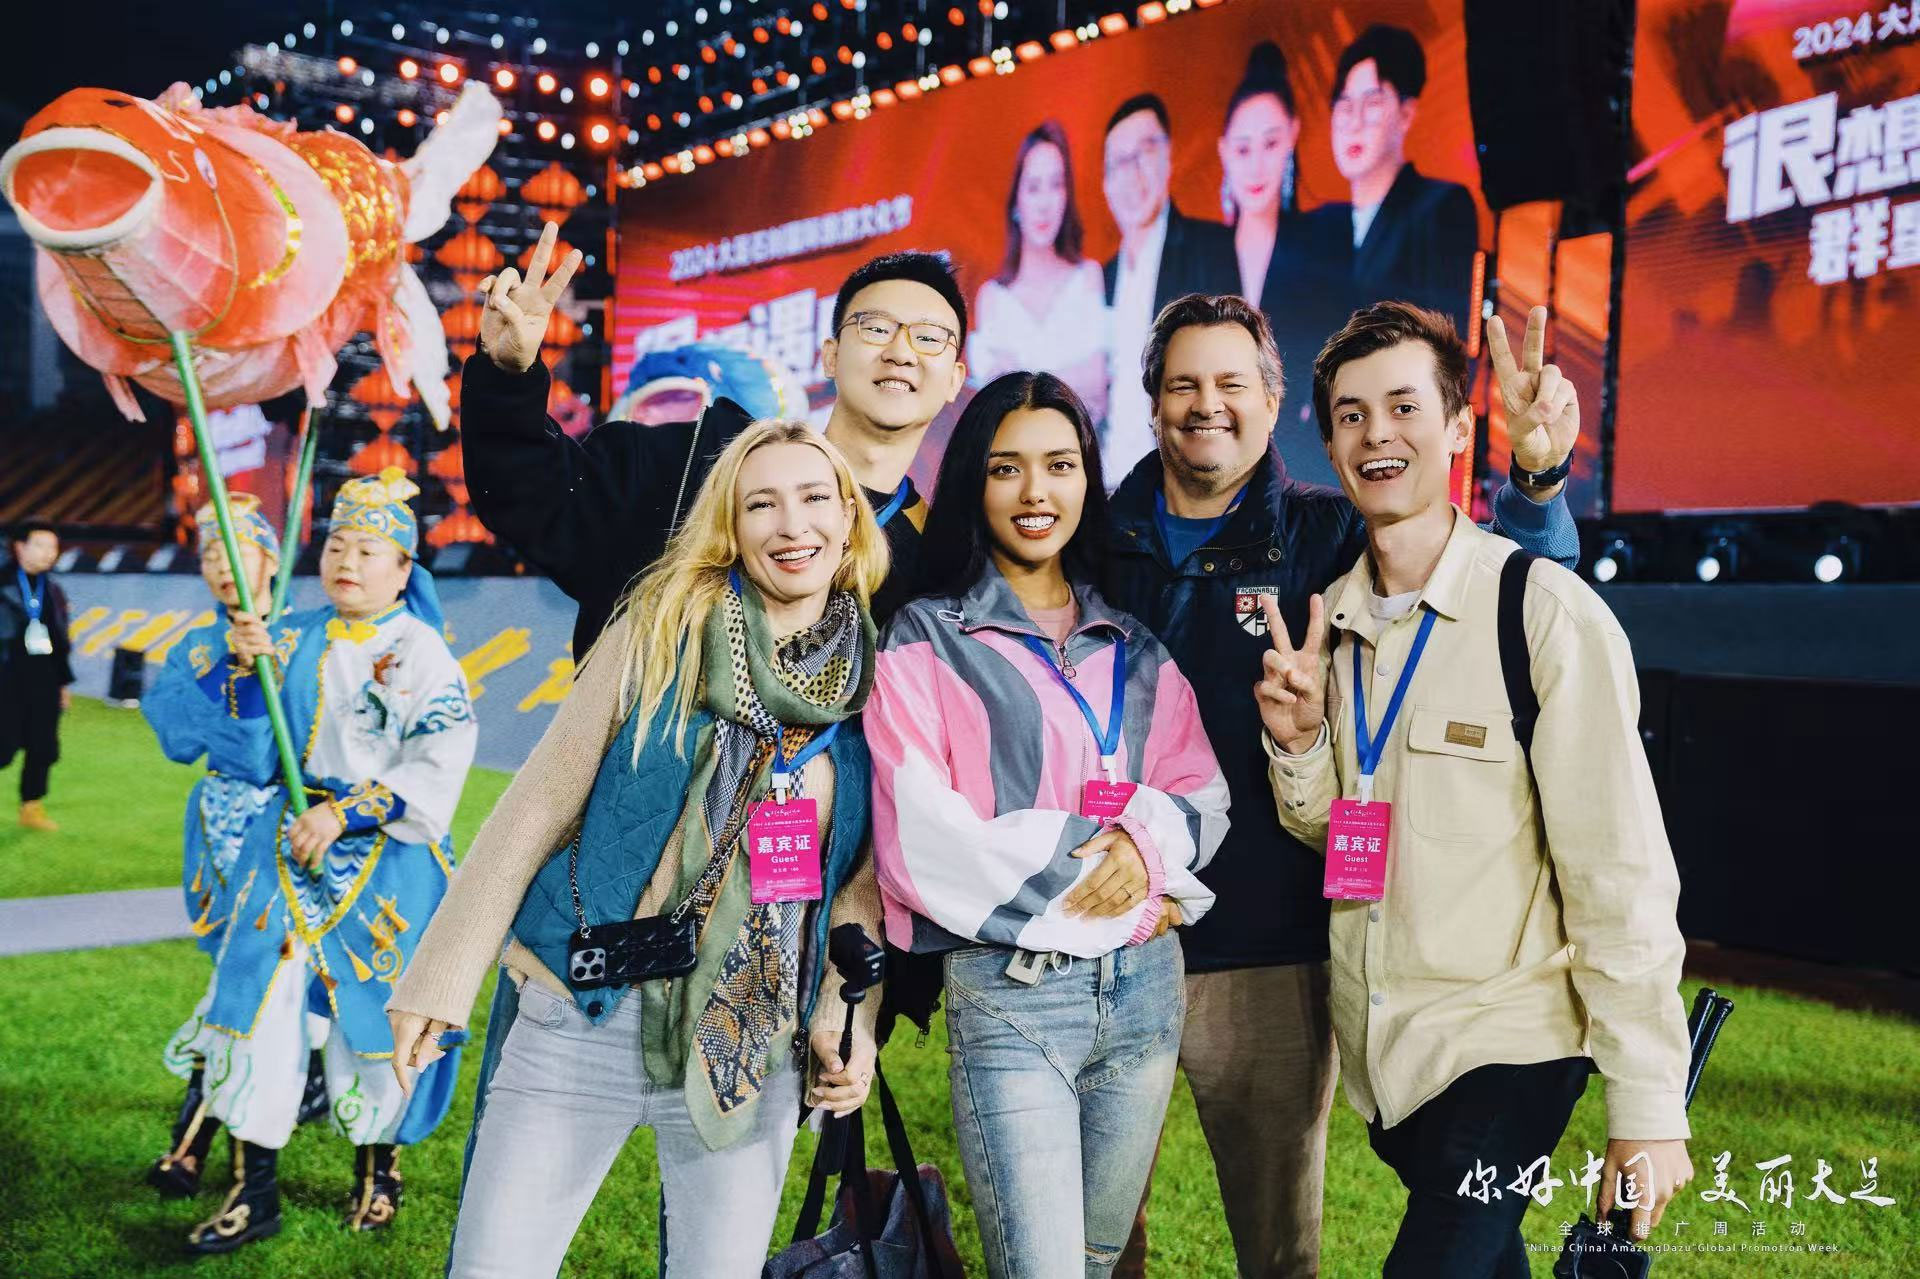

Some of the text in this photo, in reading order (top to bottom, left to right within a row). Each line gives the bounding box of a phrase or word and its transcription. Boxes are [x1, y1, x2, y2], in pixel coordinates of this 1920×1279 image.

[757, 835, 811, 853] 嘉宾证
[1334, 834, 1381, 852] 嘉宾证
[771, 855, 798, 863] Guest
[1344, 855, 1368, 863] Guest
